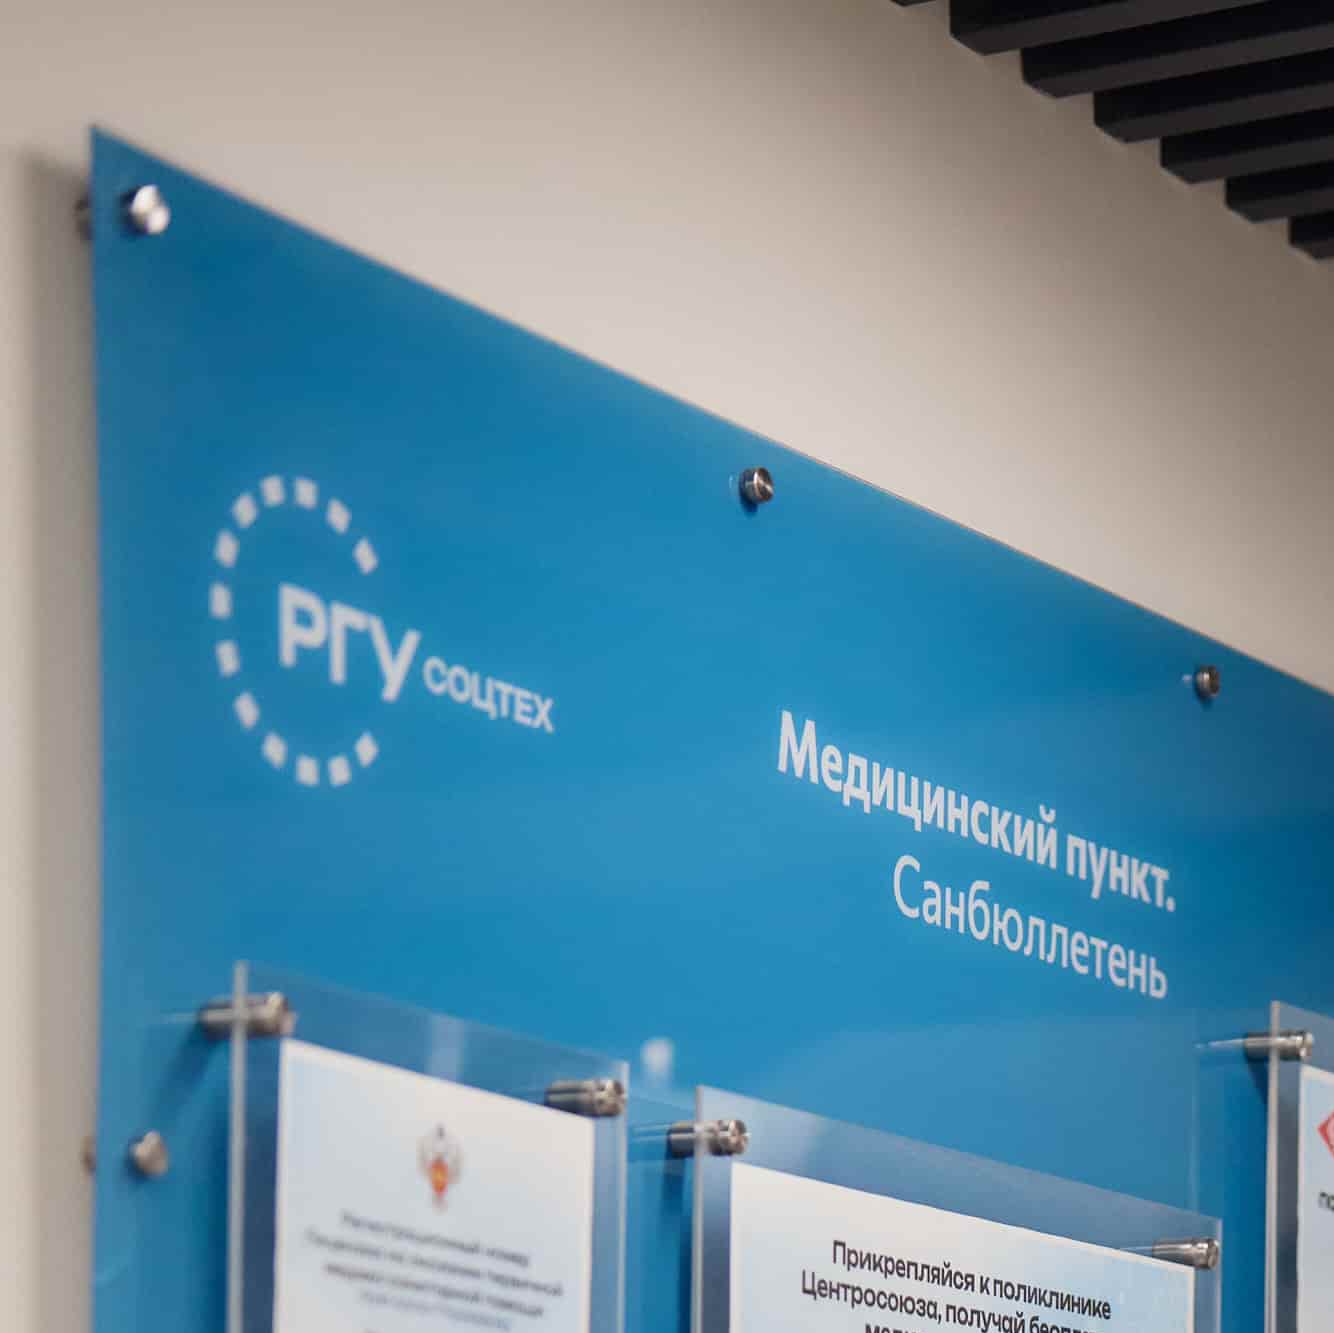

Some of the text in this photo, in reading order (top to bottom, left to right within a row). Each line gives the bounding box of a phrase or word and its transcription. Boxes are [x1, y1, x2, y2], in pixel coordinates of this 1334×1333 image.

[279, 583, 554, 734] РГУ СОЦТЕХ
[777, 710, 1177, 911] Медицинский пункт.
[893, 855, 1169, 999] Санбюллетень
[801, 1269, 941, 1322] Центросоюза,
[832, 1239, 1111, 1320] Прикрепляйся к поликлинике
